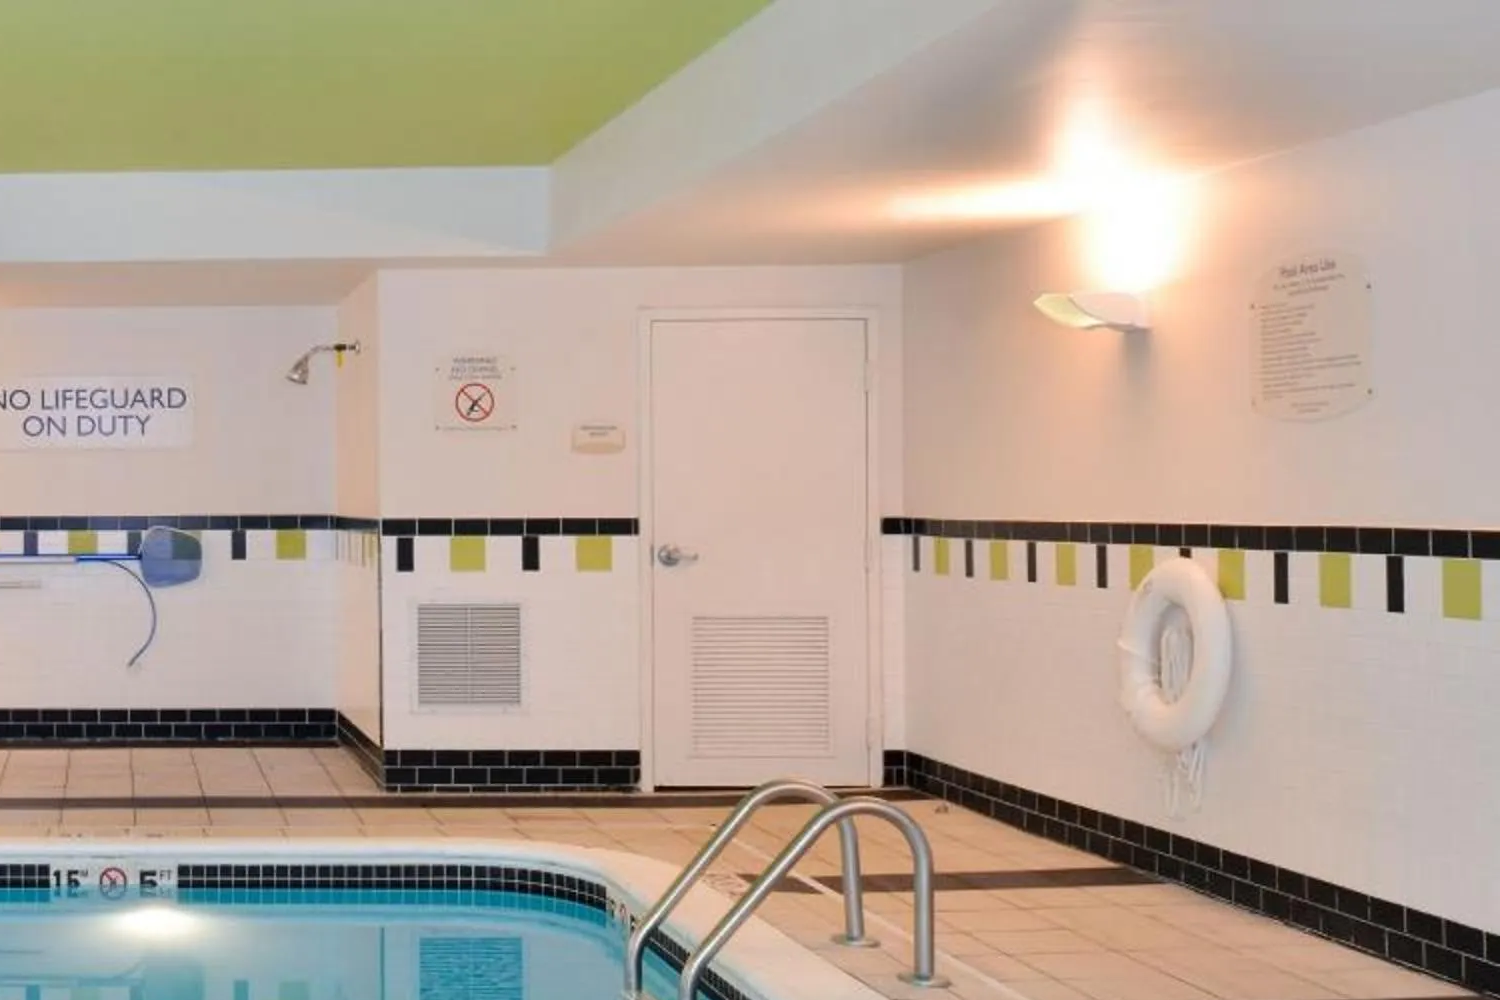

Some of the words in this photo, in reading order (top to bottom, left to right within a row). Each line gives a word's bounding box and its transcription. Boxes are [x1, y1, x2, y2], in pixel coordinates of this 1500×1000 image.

[41, 387, 187, 411] LIFEGUARD
[23, 415, 66, 437] ON
[77, 415, 150, 437] DUTY
